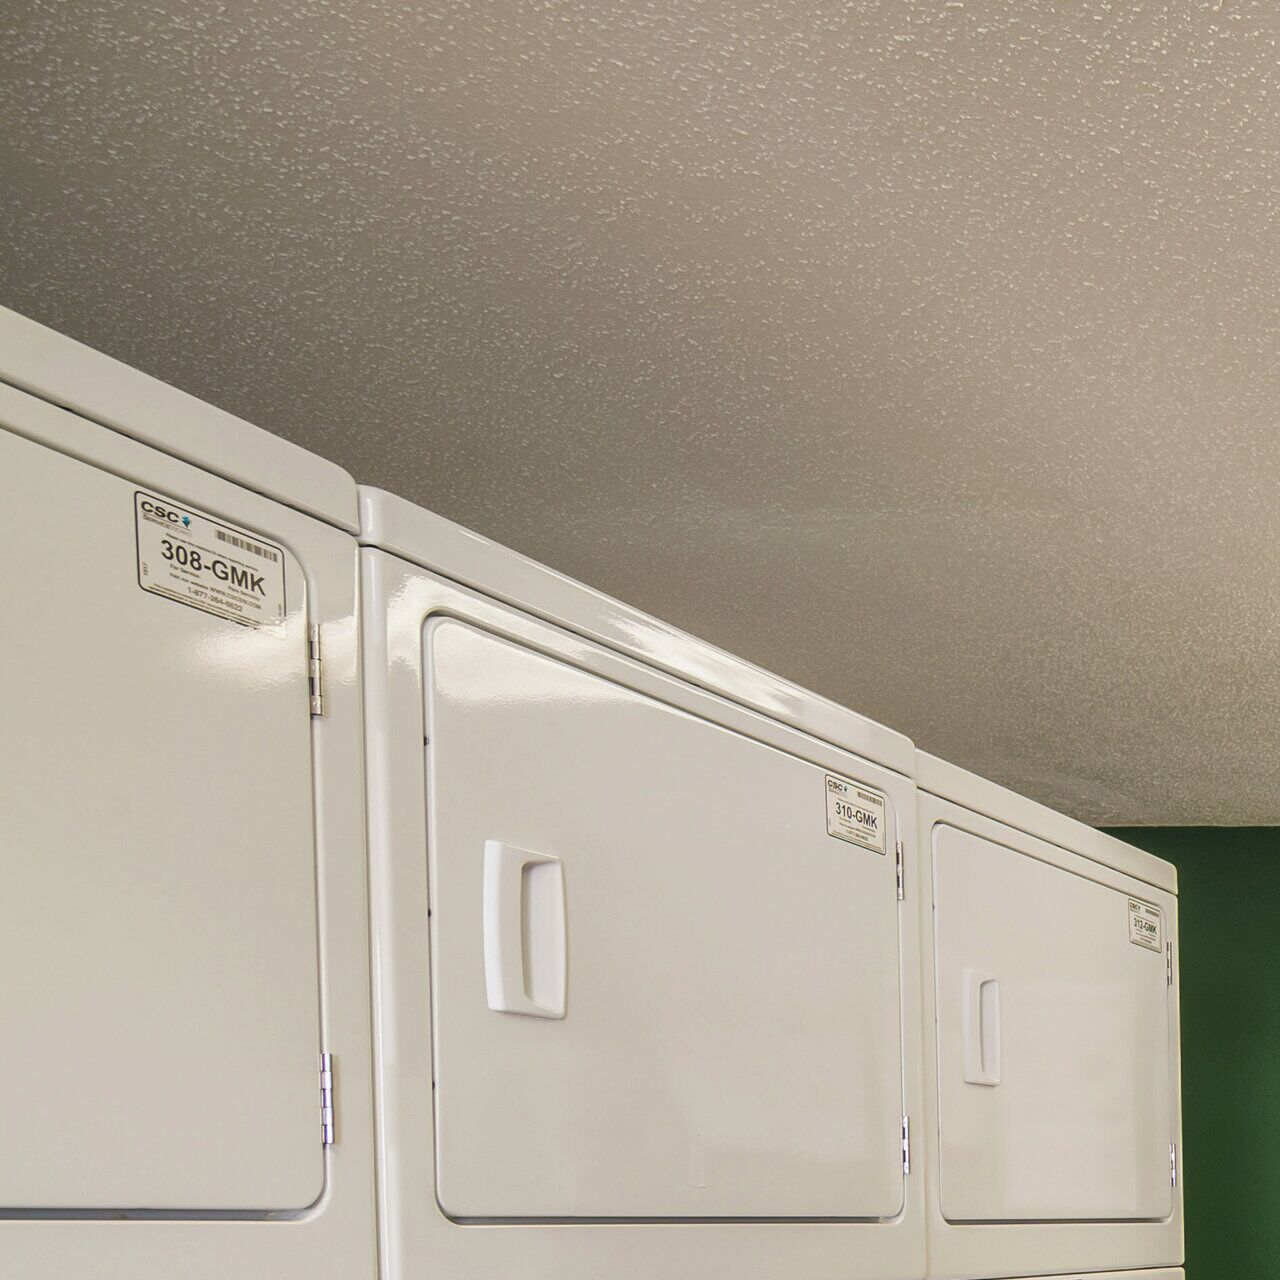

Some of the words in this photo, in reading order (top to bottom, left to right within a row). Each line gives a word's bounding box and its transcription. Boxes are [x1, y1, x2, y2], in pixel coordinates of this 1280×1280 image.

[140, 501, 179, 523] CSC
[161, 540, 266, 596] 308-GMK
[828, 780, 843, 791] CSC
[835, 802, 878, 830] 310-GMK
